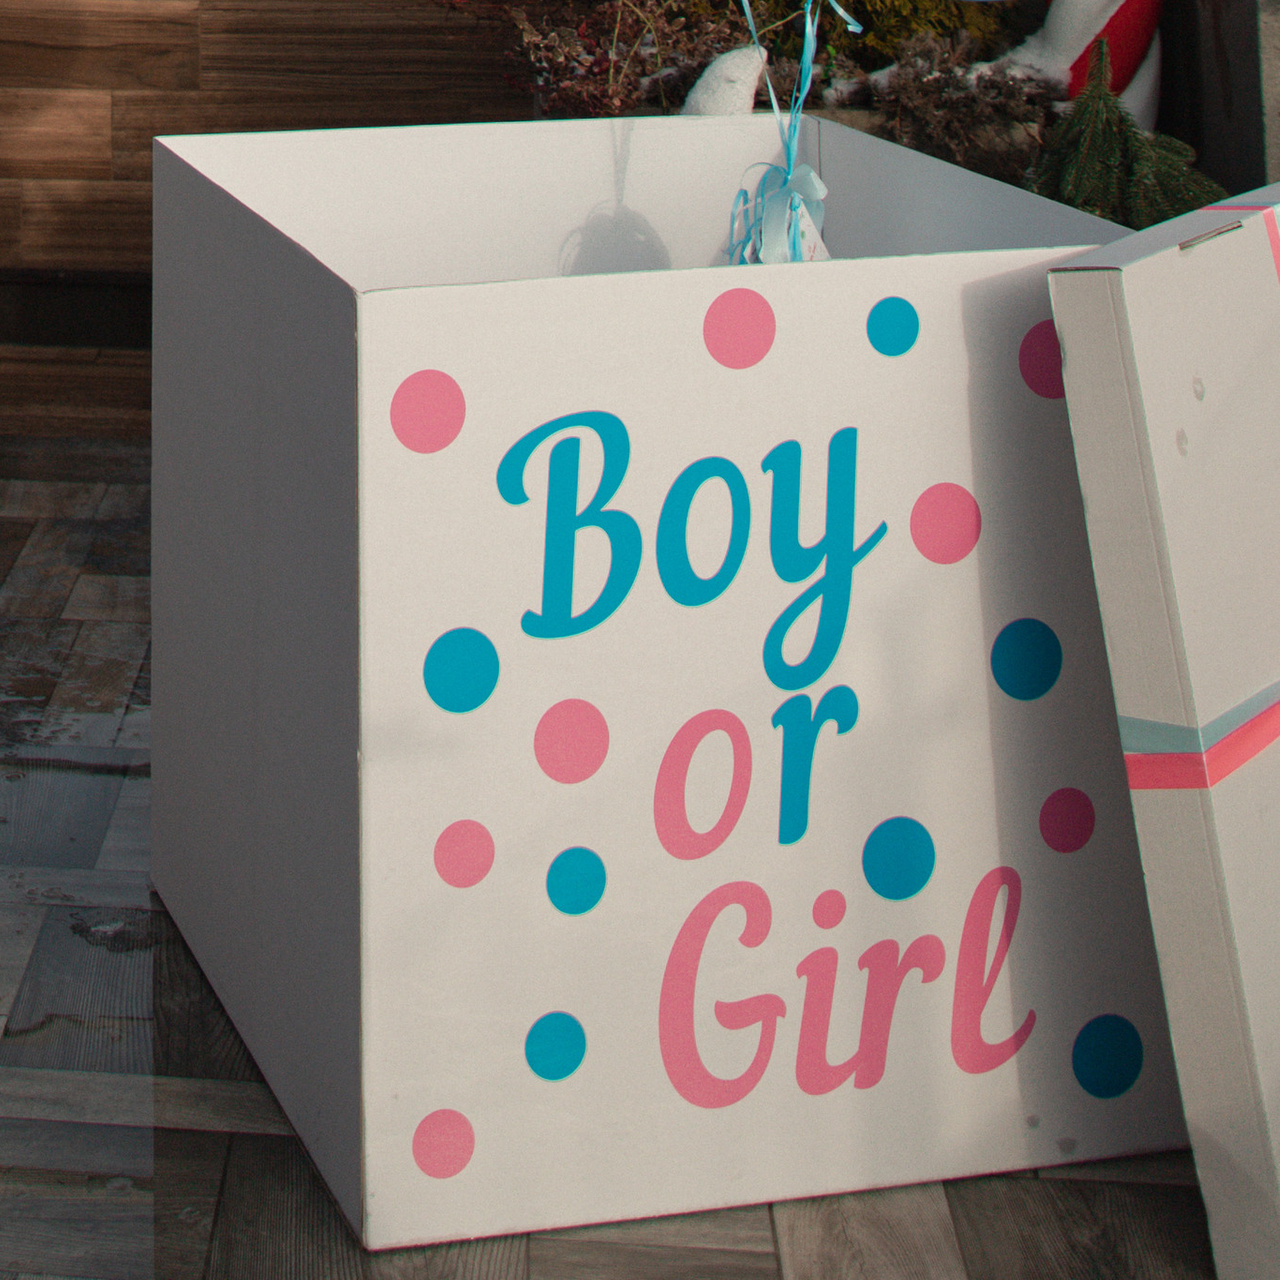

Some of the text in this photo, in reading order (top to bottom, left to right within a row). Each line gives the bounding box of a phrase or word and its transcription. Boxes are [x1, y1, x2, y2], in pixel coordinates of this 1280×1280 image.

[496, 410, 888, 691] Boy
[653, 685, 859, 861] or
[658, 866, 1037, 1109] Girl
